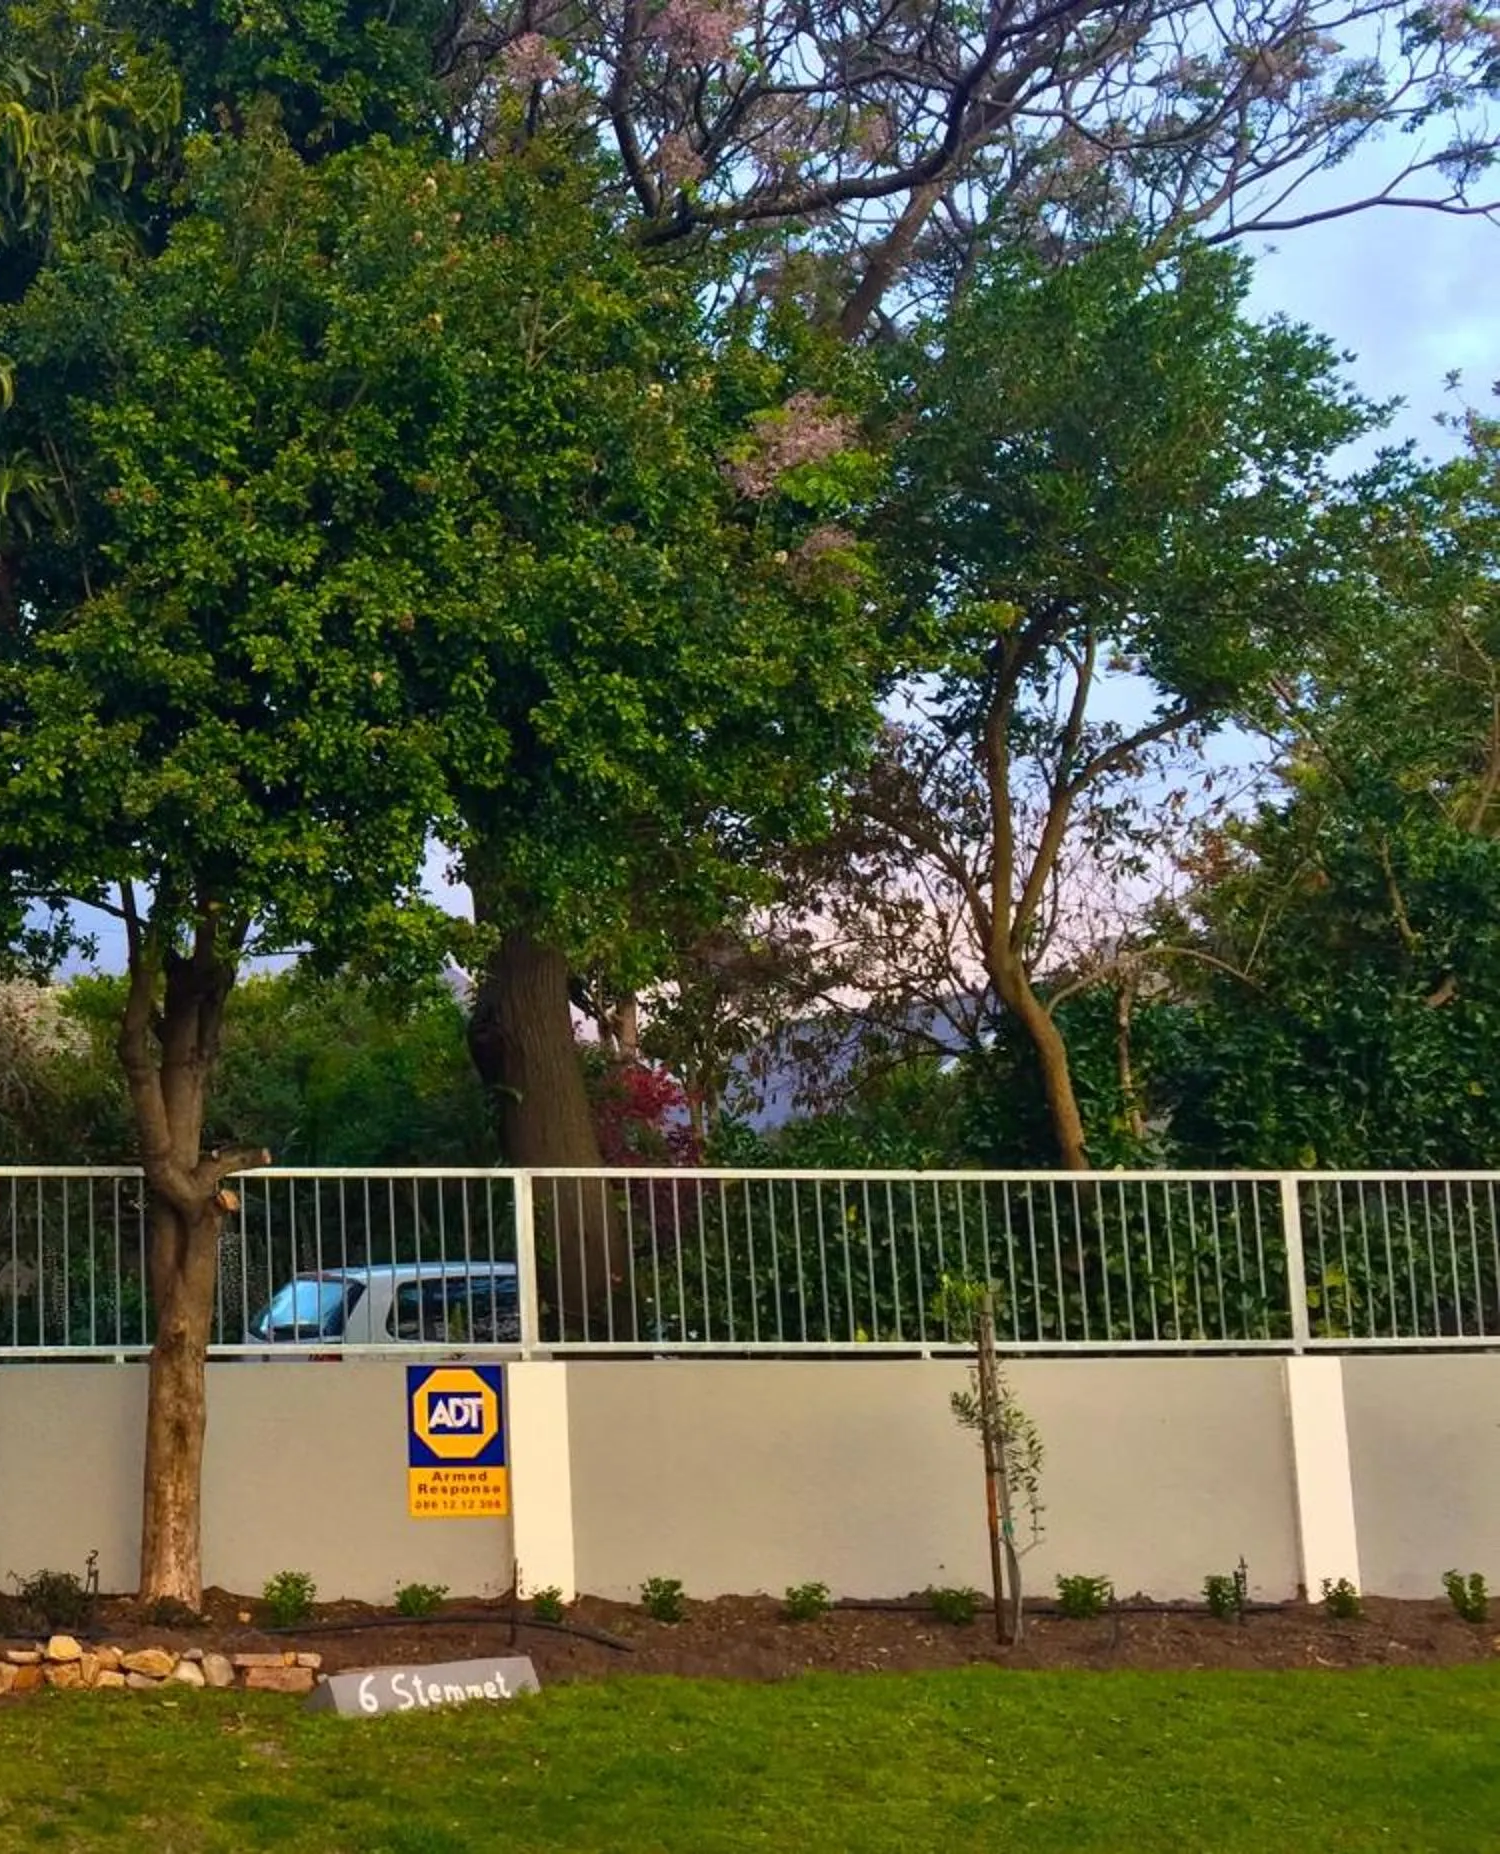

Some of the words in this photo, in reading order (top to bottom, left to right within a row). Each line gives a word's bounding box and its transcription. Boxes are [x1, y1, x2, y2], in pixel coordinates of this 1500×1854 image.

[429, 1397, 484, 1429] ADT
[431, 1471, 488, 1481] Armed
[417, 1483, 501, 1496] Response
[358, 1674, 379, 1713] 6
[391, 1671, 512, 1710] Stemmet
